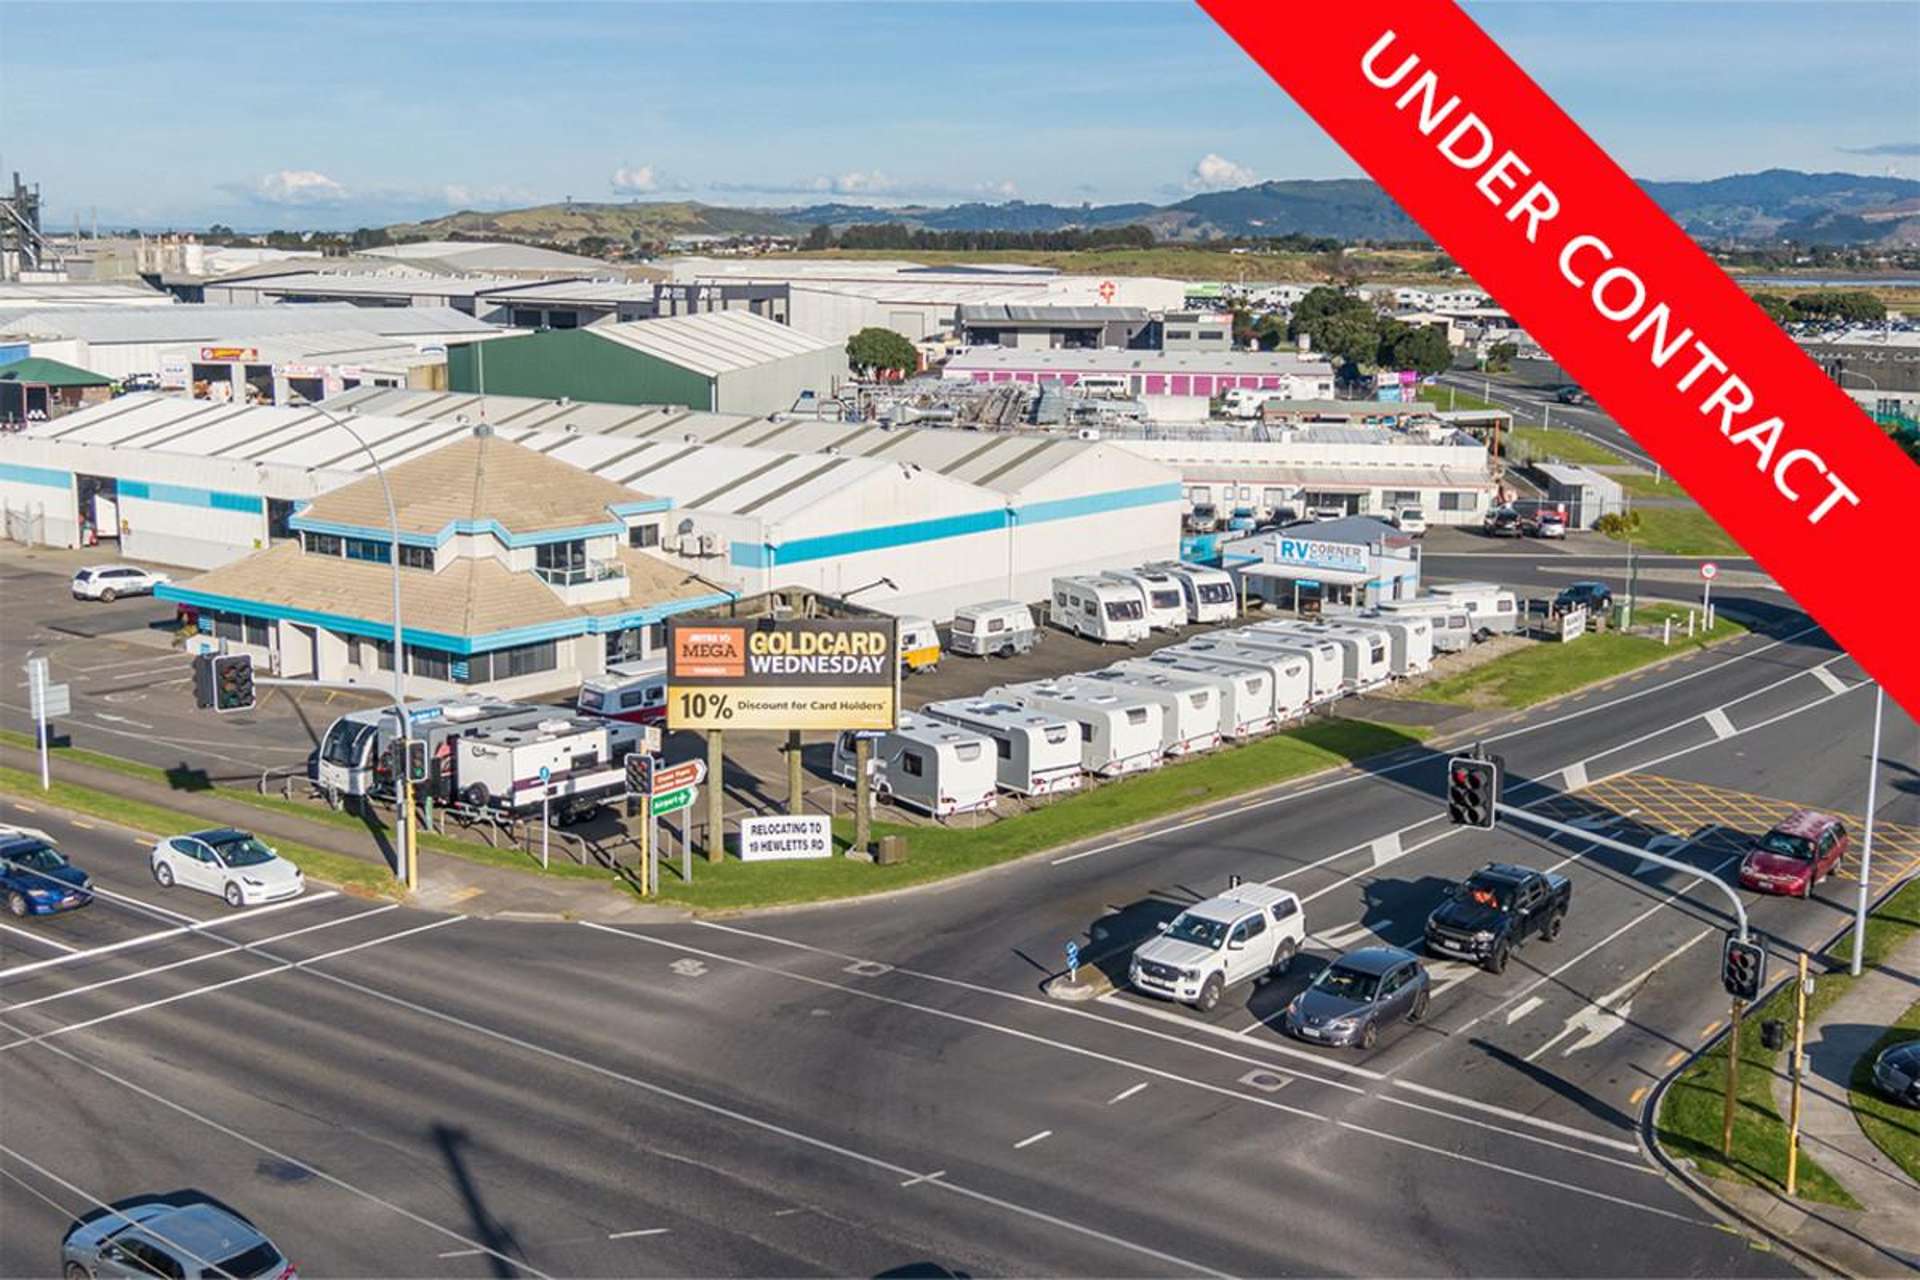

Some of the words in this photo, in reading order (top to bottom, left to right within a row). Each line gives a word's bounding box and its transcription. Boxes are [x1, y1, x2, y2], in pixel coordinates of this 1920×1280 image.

[1281, 540, 1309, 560] RV
[1310, 543, 1362, 557] CORNER
[682, 643, 738, 658] MEGA
[749, 631, 887, 656] GOLDCARD
[750, 655, 886, 674] WEDNESDAY
[680, 693, 733, 719] 10%
[737, 700, 788, 711] Discount
[791, 700, 807, 710] for
[809, 700, 837, 711] Card
[751, 822, 807, 836] RELOCATING
[810, 822, 822, 834] TO
[749, 841, 758, 852] 19
[761, 839, 809, 852] HEWLETTS
[811, 838, 825, 850] RD
